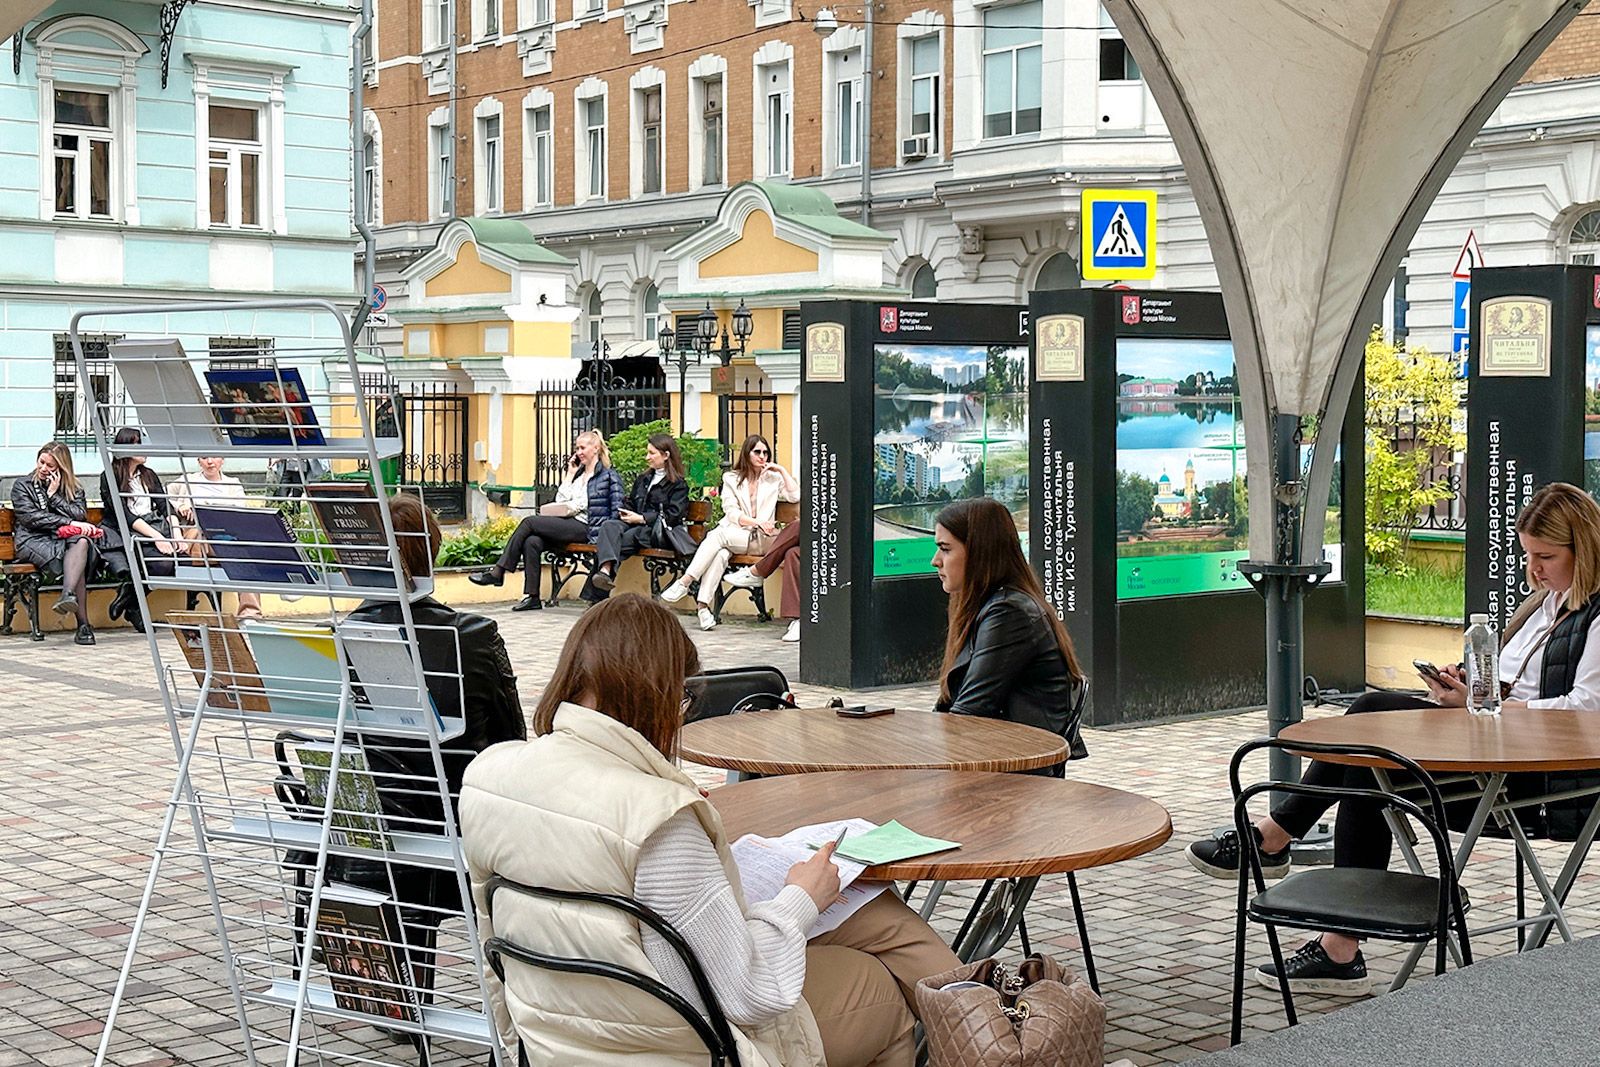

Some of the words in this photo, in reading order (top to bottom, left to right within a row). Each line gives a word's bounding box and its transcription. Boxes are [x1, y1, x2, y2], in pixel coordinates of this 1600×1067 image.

[333, 504, 356, 515] IVAN
[811, 414, 821, 533] государственная
[828, 453, 838, 525] Тургенева
[1043, 418, 1054, 551] государственная
[1065, 461, 1077, 542] Тургенева
[1488, 421, 1501, 580] государственная
[333, 518, 369, 528] TRUNIN
[819, 443, 828, 595] Библиотека-читальня
[828, 528, 838, 559] И.С.
[810, 541, 819, 624] Московская
[829, 563, 837, 587] им.
[1065, 546, 1075, 581] И.С.
[1067, 585, 1075, 612] им.
